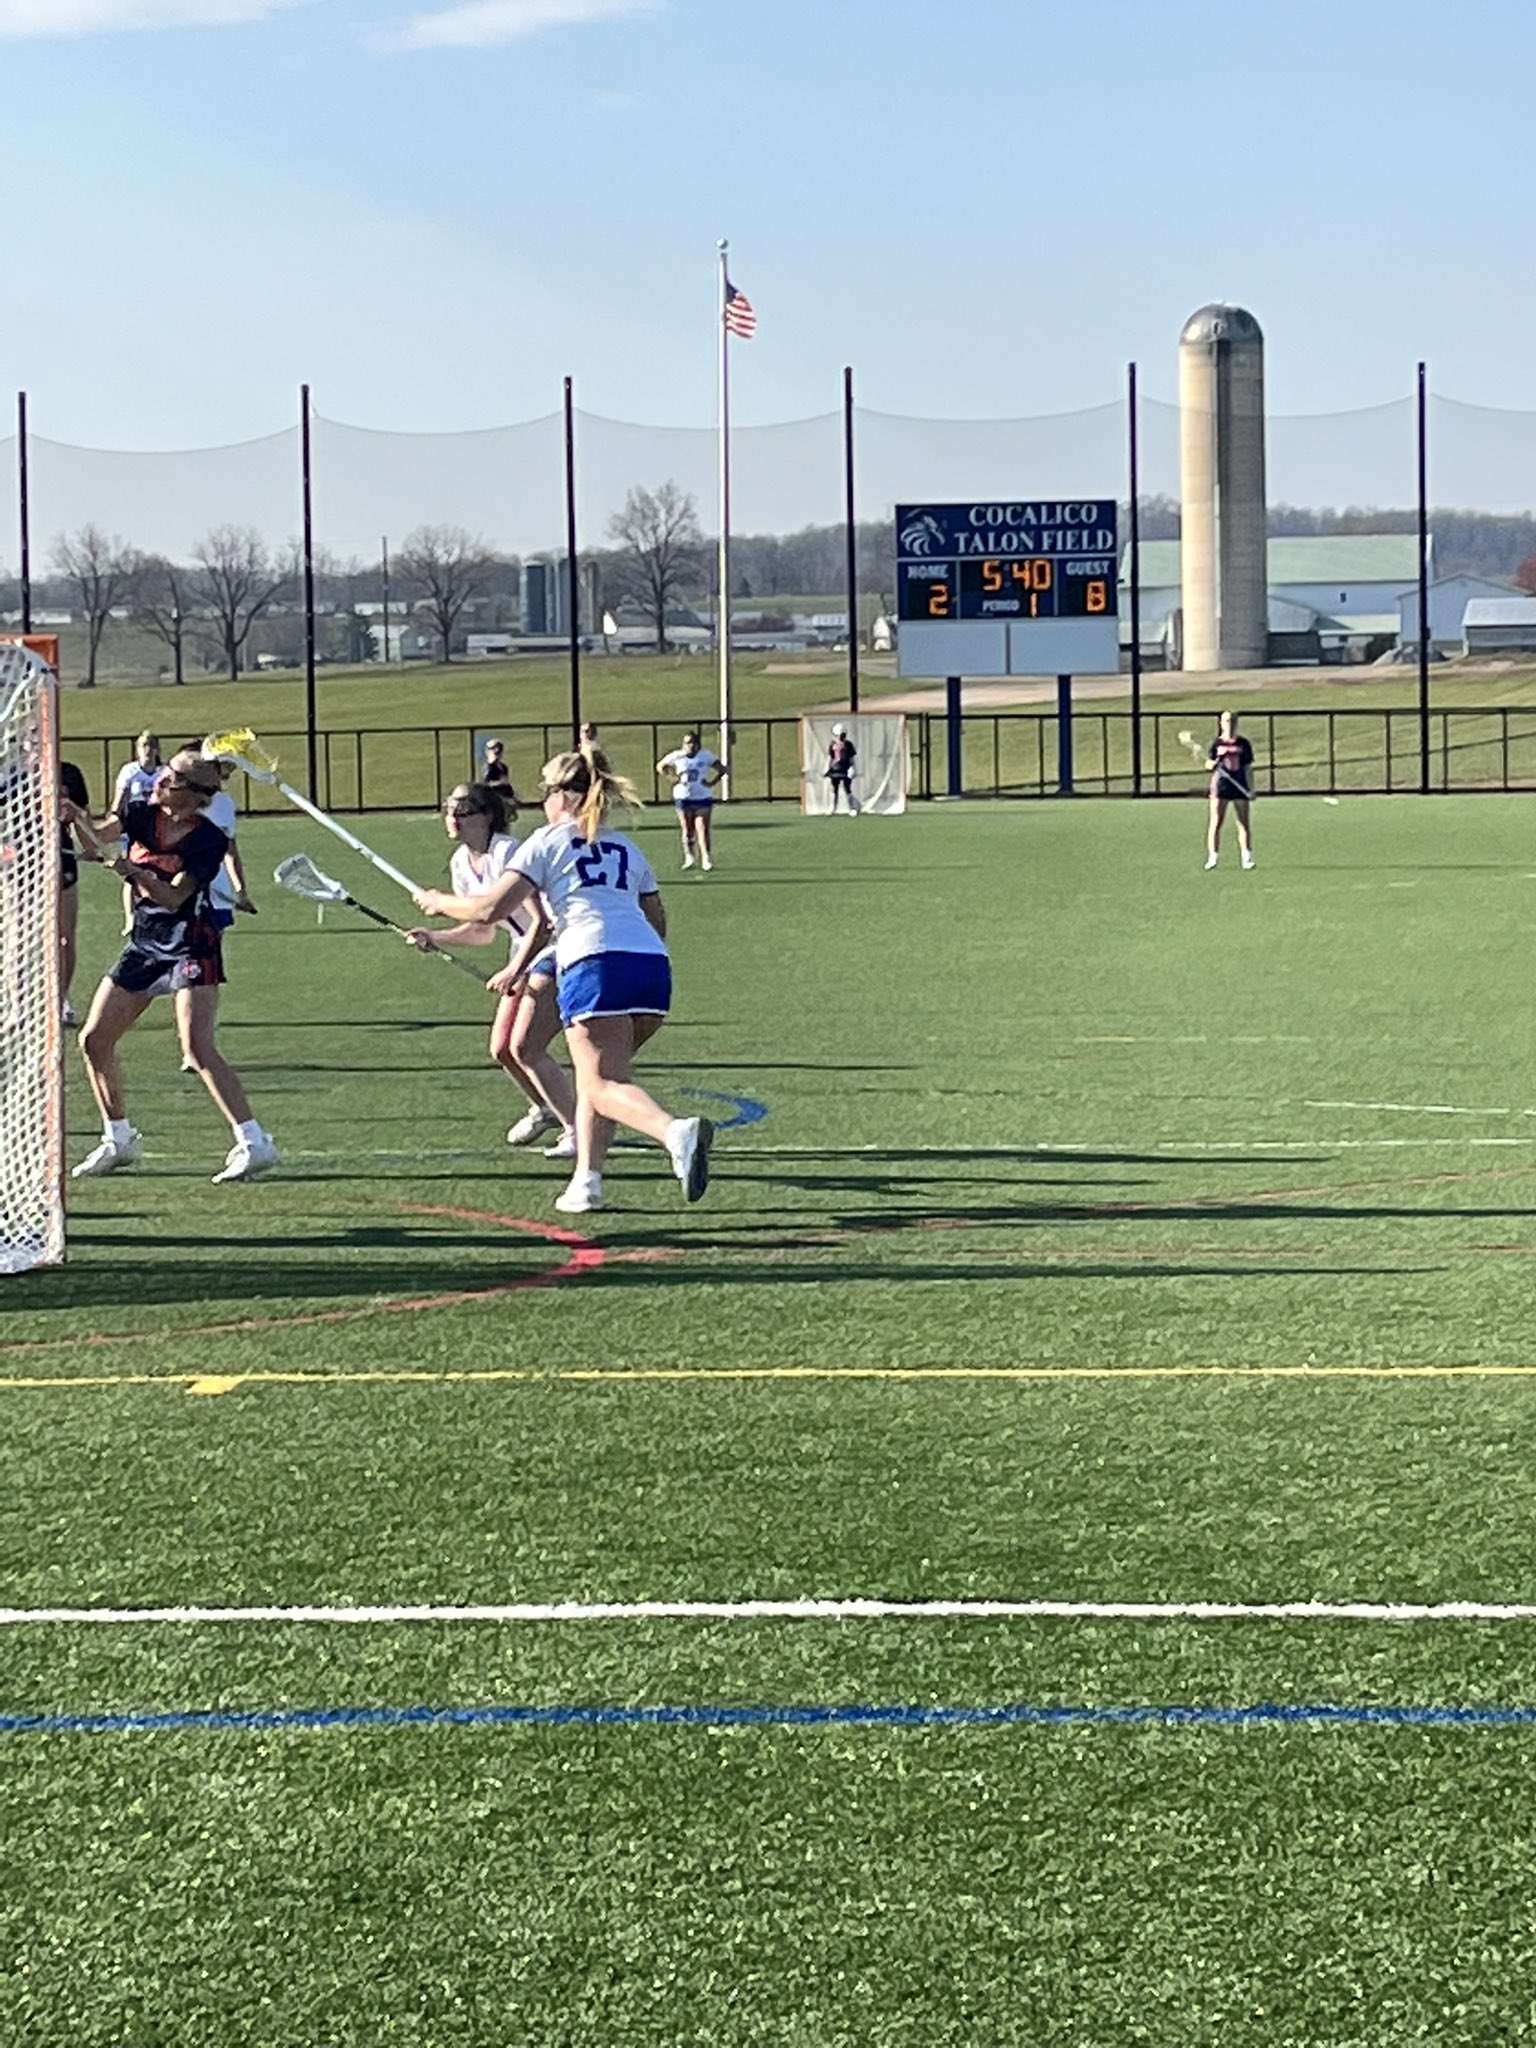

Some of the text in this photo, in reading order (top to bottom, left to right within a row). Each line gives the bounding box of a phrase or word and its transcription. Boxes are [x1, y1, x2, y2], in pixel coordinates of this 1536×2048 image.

[969, 504, 1098, 526] COCALICO
[954, 529, 1113, 553] TALON FIELD
[907, 564, 949, 579] HOME
[1066, 560, 1109, 576] GUEST
[929, 584, 948, 615] 2
[571, 837, 629, 890] 27
